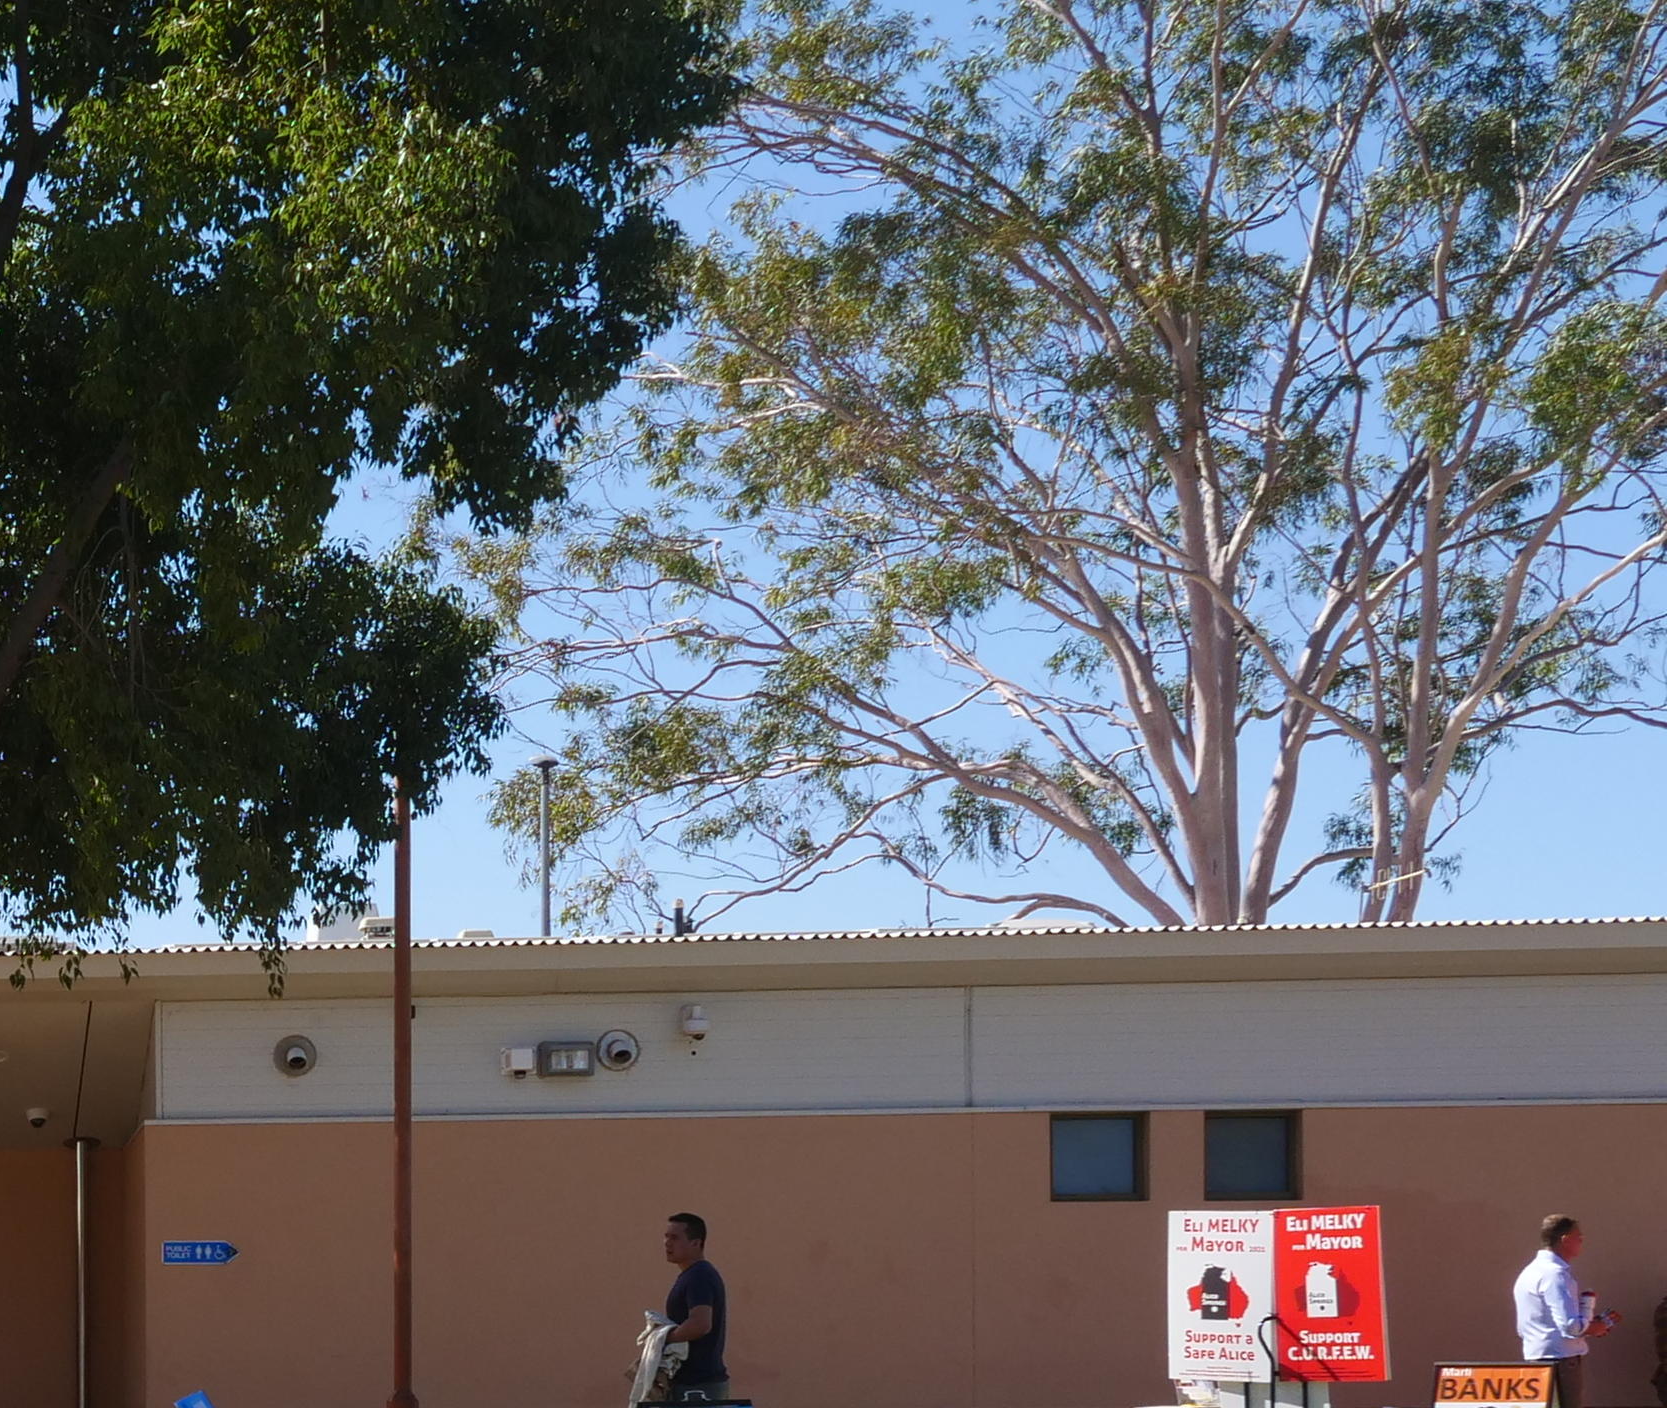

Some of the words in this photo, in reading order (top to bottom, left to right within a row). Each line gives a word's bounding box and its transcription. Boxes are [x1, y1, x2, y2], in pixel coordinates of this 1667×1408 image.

[1208, 1219, 1259, 1233] MELKY
[1311, 1213, 1365, 1230] MELKY
[1288, 1346, 1374, 1361] C.U.R.F.E.W.
[1441, 1378, 1540, 1400] BANKS
